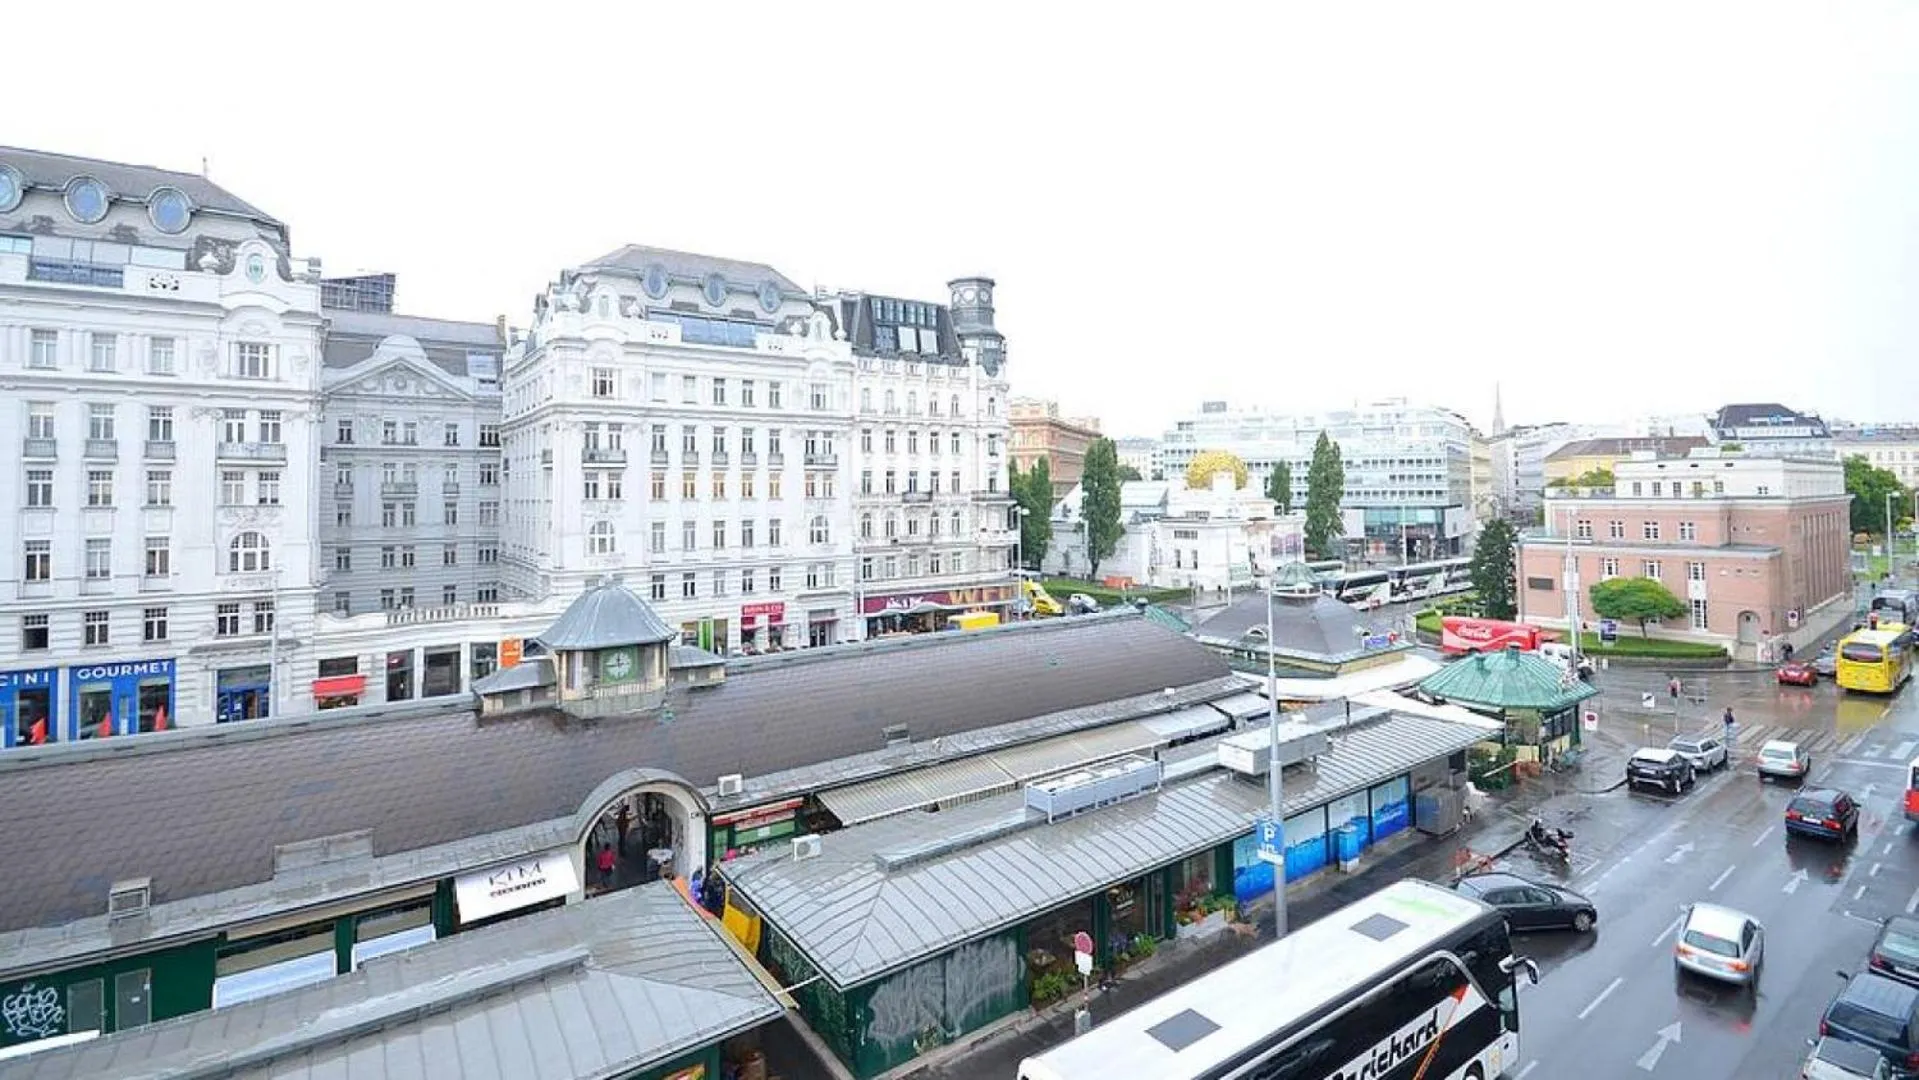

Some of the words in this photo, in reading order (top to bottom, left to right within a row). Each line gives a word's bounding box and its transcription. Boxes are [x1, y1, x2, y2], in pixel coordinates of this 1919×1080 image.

[76, 660, 171, 681] GOURMET
[1263, 826, 1275, 842] P
[488, 860, 542, 887] KIM
